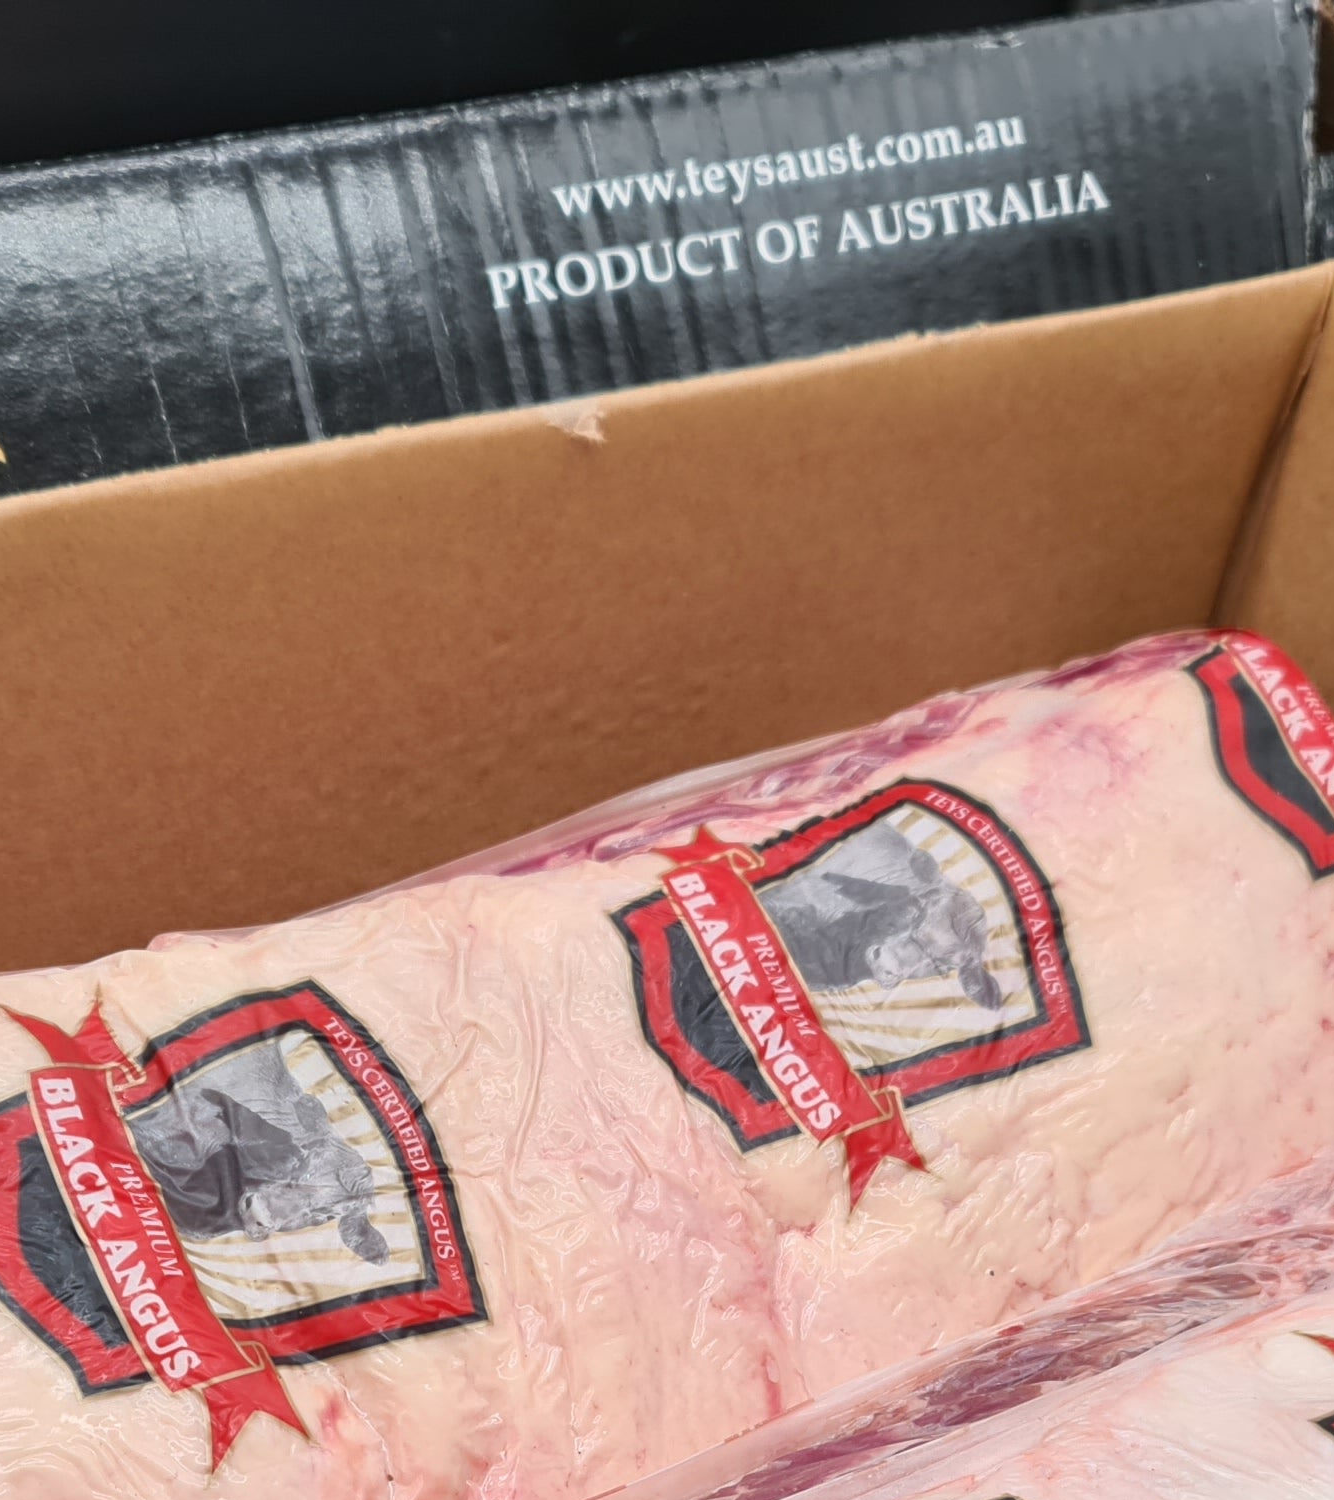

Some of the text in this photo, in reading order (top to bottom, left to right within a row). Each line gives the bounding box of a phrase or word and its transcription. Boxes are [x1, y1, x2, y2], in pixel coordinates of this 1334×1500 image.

[485, 170, 1110, 311] PRODUCT OF AUSTRALIA
[552, 114, 1027, 219] www.teysaust.com.au
[924, 791, 970, 821] TEYS
[967, 814, 1043, 912] CERTIFIED
[1028, 917, 1063, 996] ANGUS
[668, 871, 842, 1131] BLACK ANGUS
[746, 932, 817, 1039] PREMIUM
[110, 1161, 185, 1278] PREMIUM
[324, 1017, 369, 1068] TEYS
[362, 1067, 430, 1172] CERTIFIED
[418, 1177, 455, 1260] ANGUS
[38, 1076, 202, 1379] BLACK ANGUS
